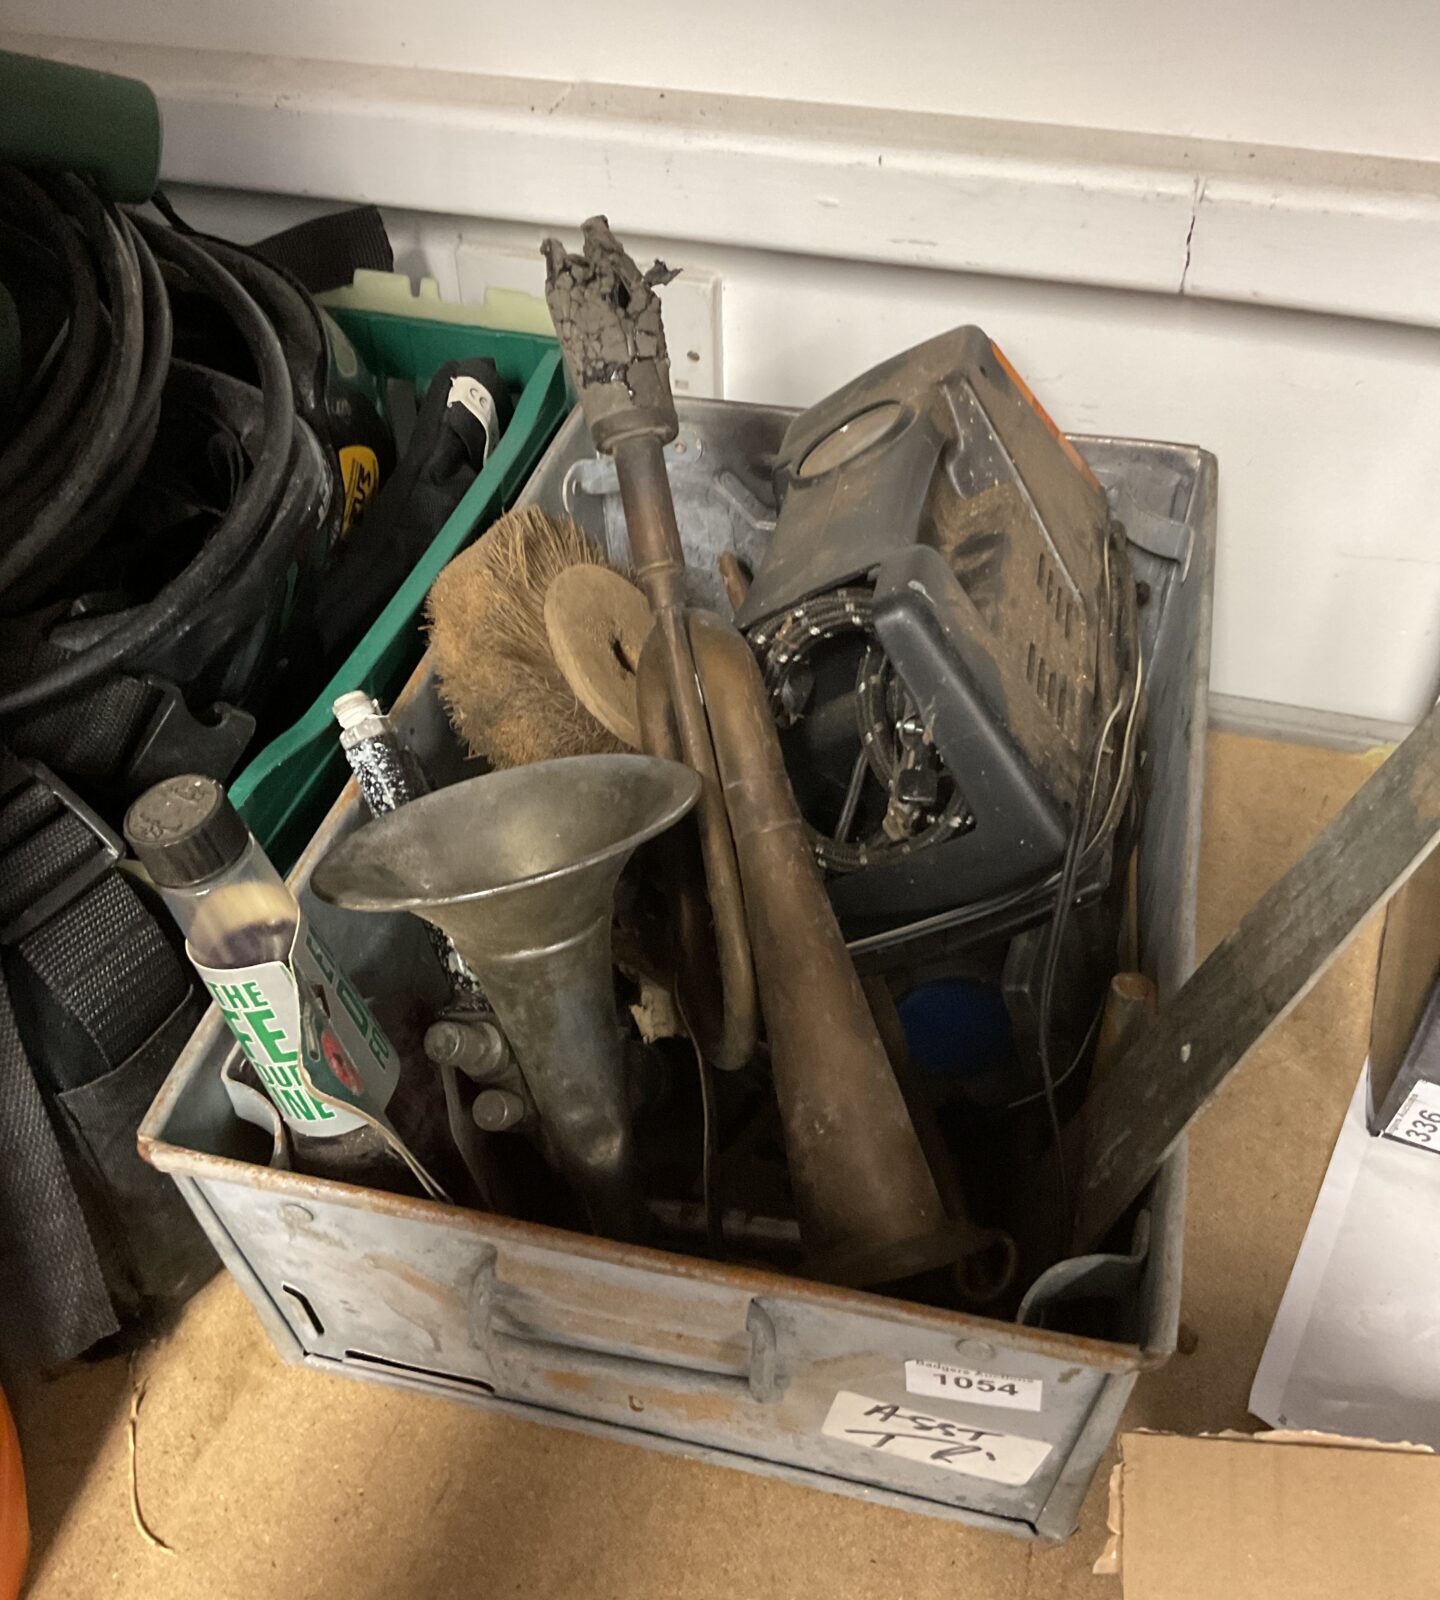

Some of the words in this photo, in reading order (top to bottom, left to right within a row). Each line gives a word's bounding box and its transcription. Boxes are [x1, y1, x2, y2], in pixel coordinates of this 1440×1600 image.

[207, 981, 269, 1008] THE
[1405, 1109, 1440, 1143] 336
[932, 1373, 1020, 1396] 1054
